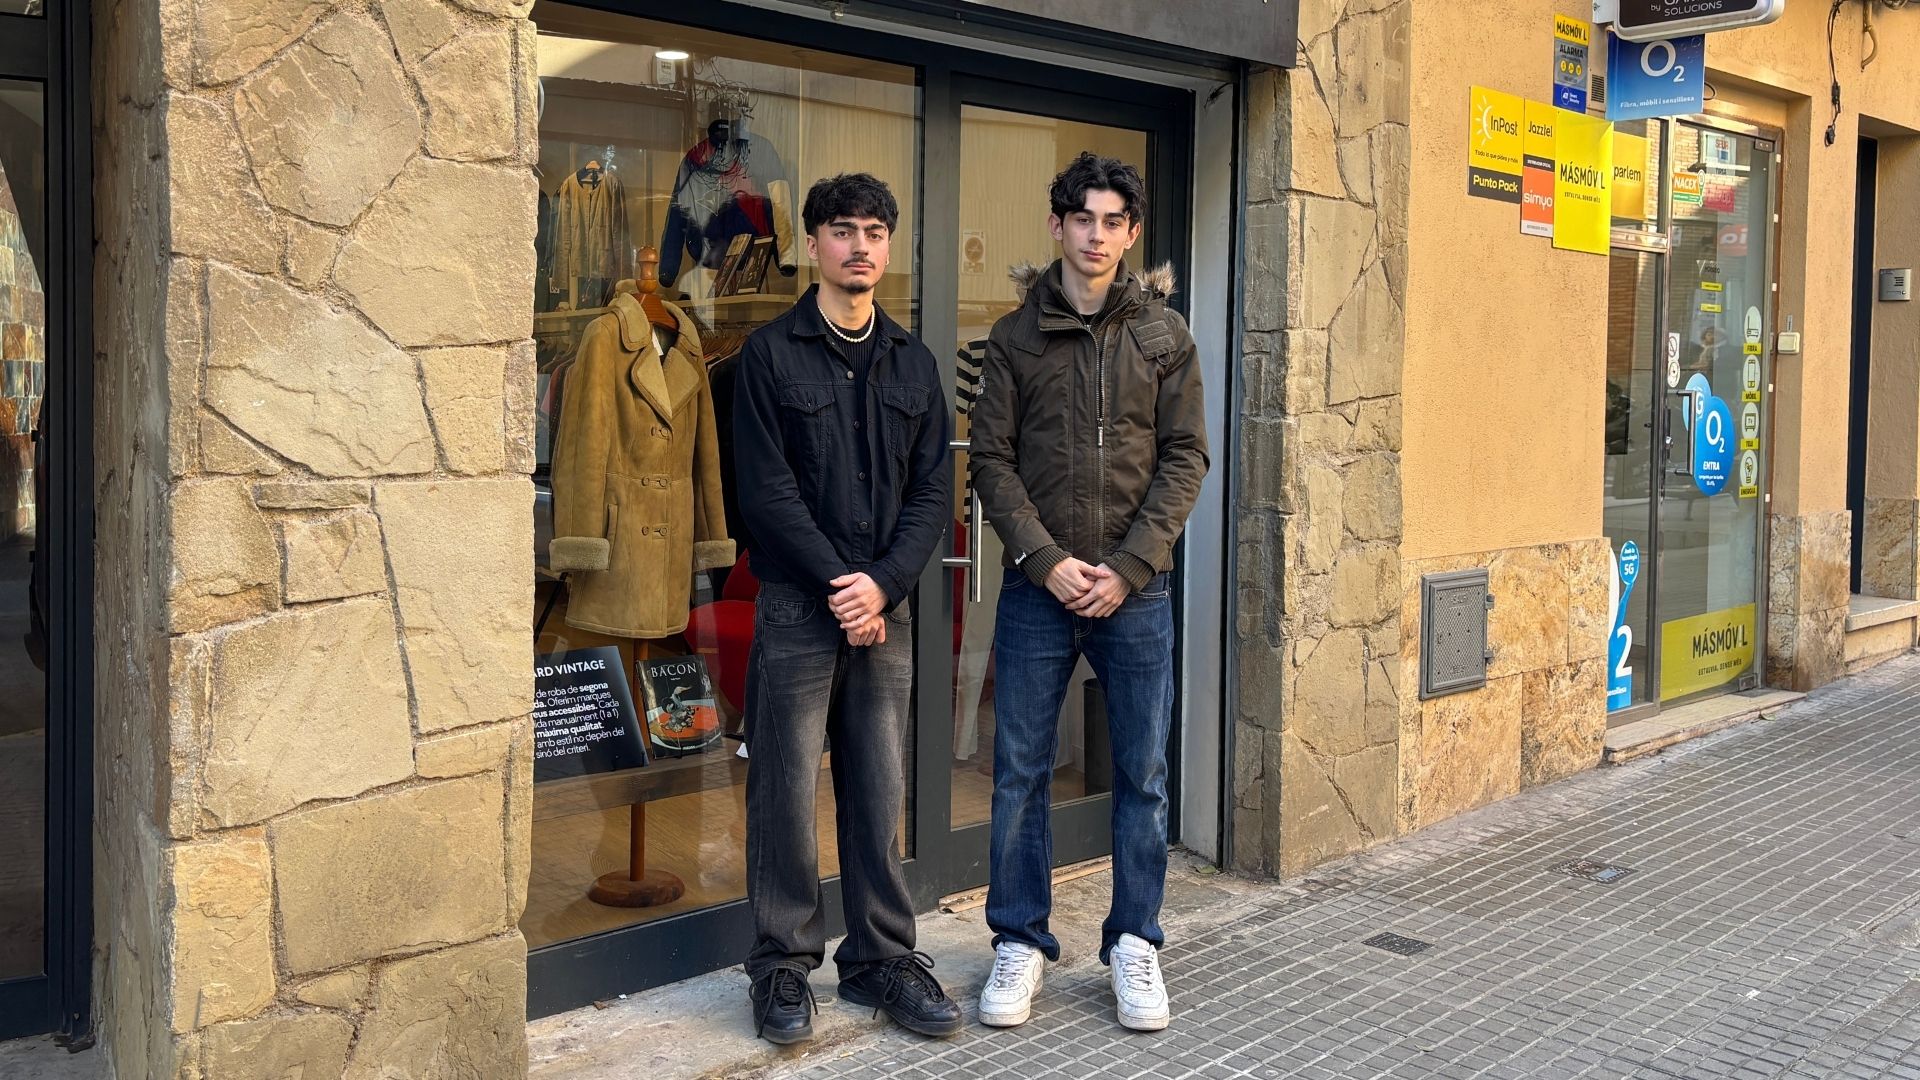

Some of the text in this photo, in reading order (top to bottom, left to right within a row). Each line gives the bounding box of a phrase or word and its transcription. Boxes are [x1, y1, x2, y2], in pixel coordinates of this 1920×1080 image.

[1650, 0, 1723, 17] by SOLUCIONS
[1559, 44, 1584, 58] ALARMA
[1490, 114, 1518, 137] InPost
[1613, 165, 1641, 182] parlem
[1473, 174, 1518, 193] Punto Pack
[1674, 176, 1697, 191] NACEX
[1523, 189, 1553, 211] simyo
[1624, 562, 1635, 576] 5G
[555, 659, 606, 675] VINTAGE
[650, 662, 697, 678] BACON
[535, 682, 609, 699] de roba de segona
[547, 696, 577, 707] Oferim
[577, 692, 612, 703] marques
[548, 703, 598, 717] accessibles.
[598, 699, 620, 709] Cada
[548, 712, 599, 727] manualment
[536, 721, 604, 739] màxima qualitat.
[537, 738, 556, 749] amb
[556, 735, 573, 745] estil
[585, 730, 612, 743] depèn
[612, 727, 625, 737] del
[535, 743, 591, 759] sinó del criteri.
